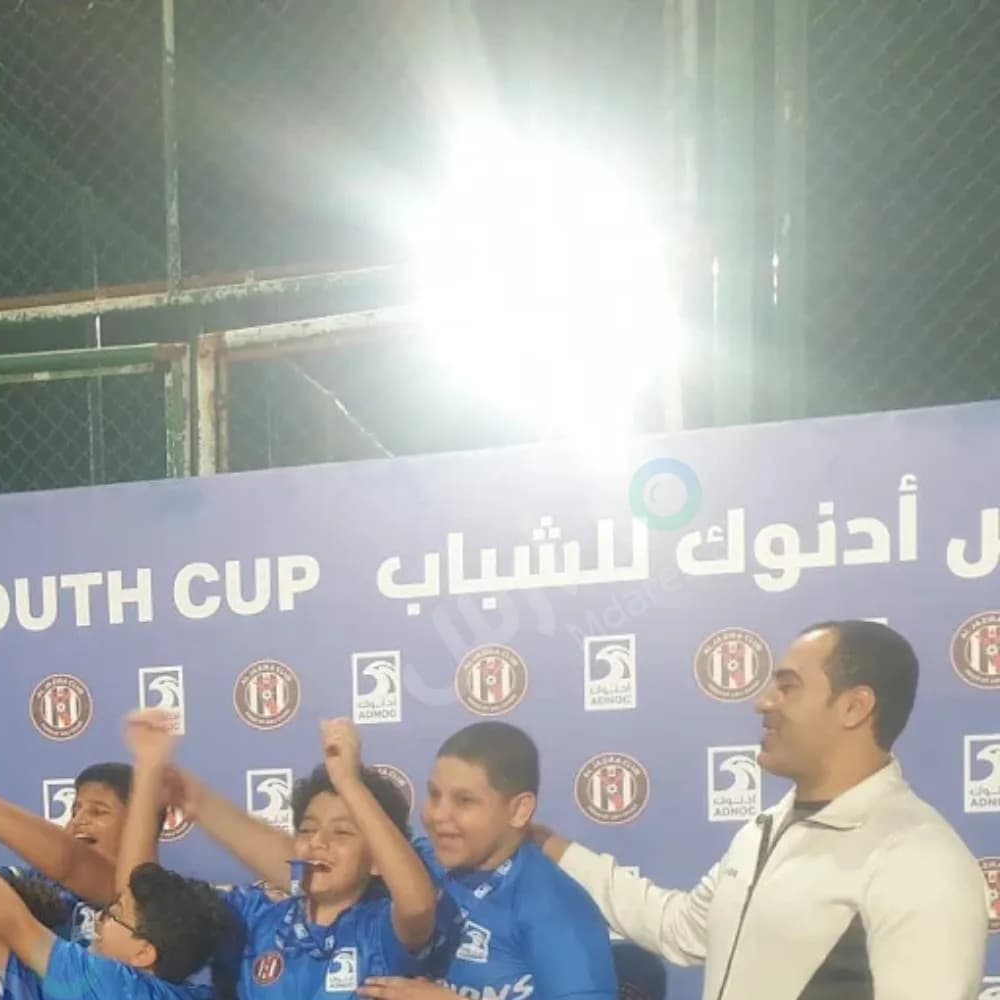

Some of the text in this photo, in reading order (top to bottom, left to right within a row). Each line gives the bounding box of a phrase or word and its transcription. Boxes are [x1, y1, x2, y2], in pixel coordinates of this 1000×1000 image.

[376, 515, 650, 615] للشباب
[675, 473, 918, 592] أدنوك
[174, 554, 320, 619] CUP
